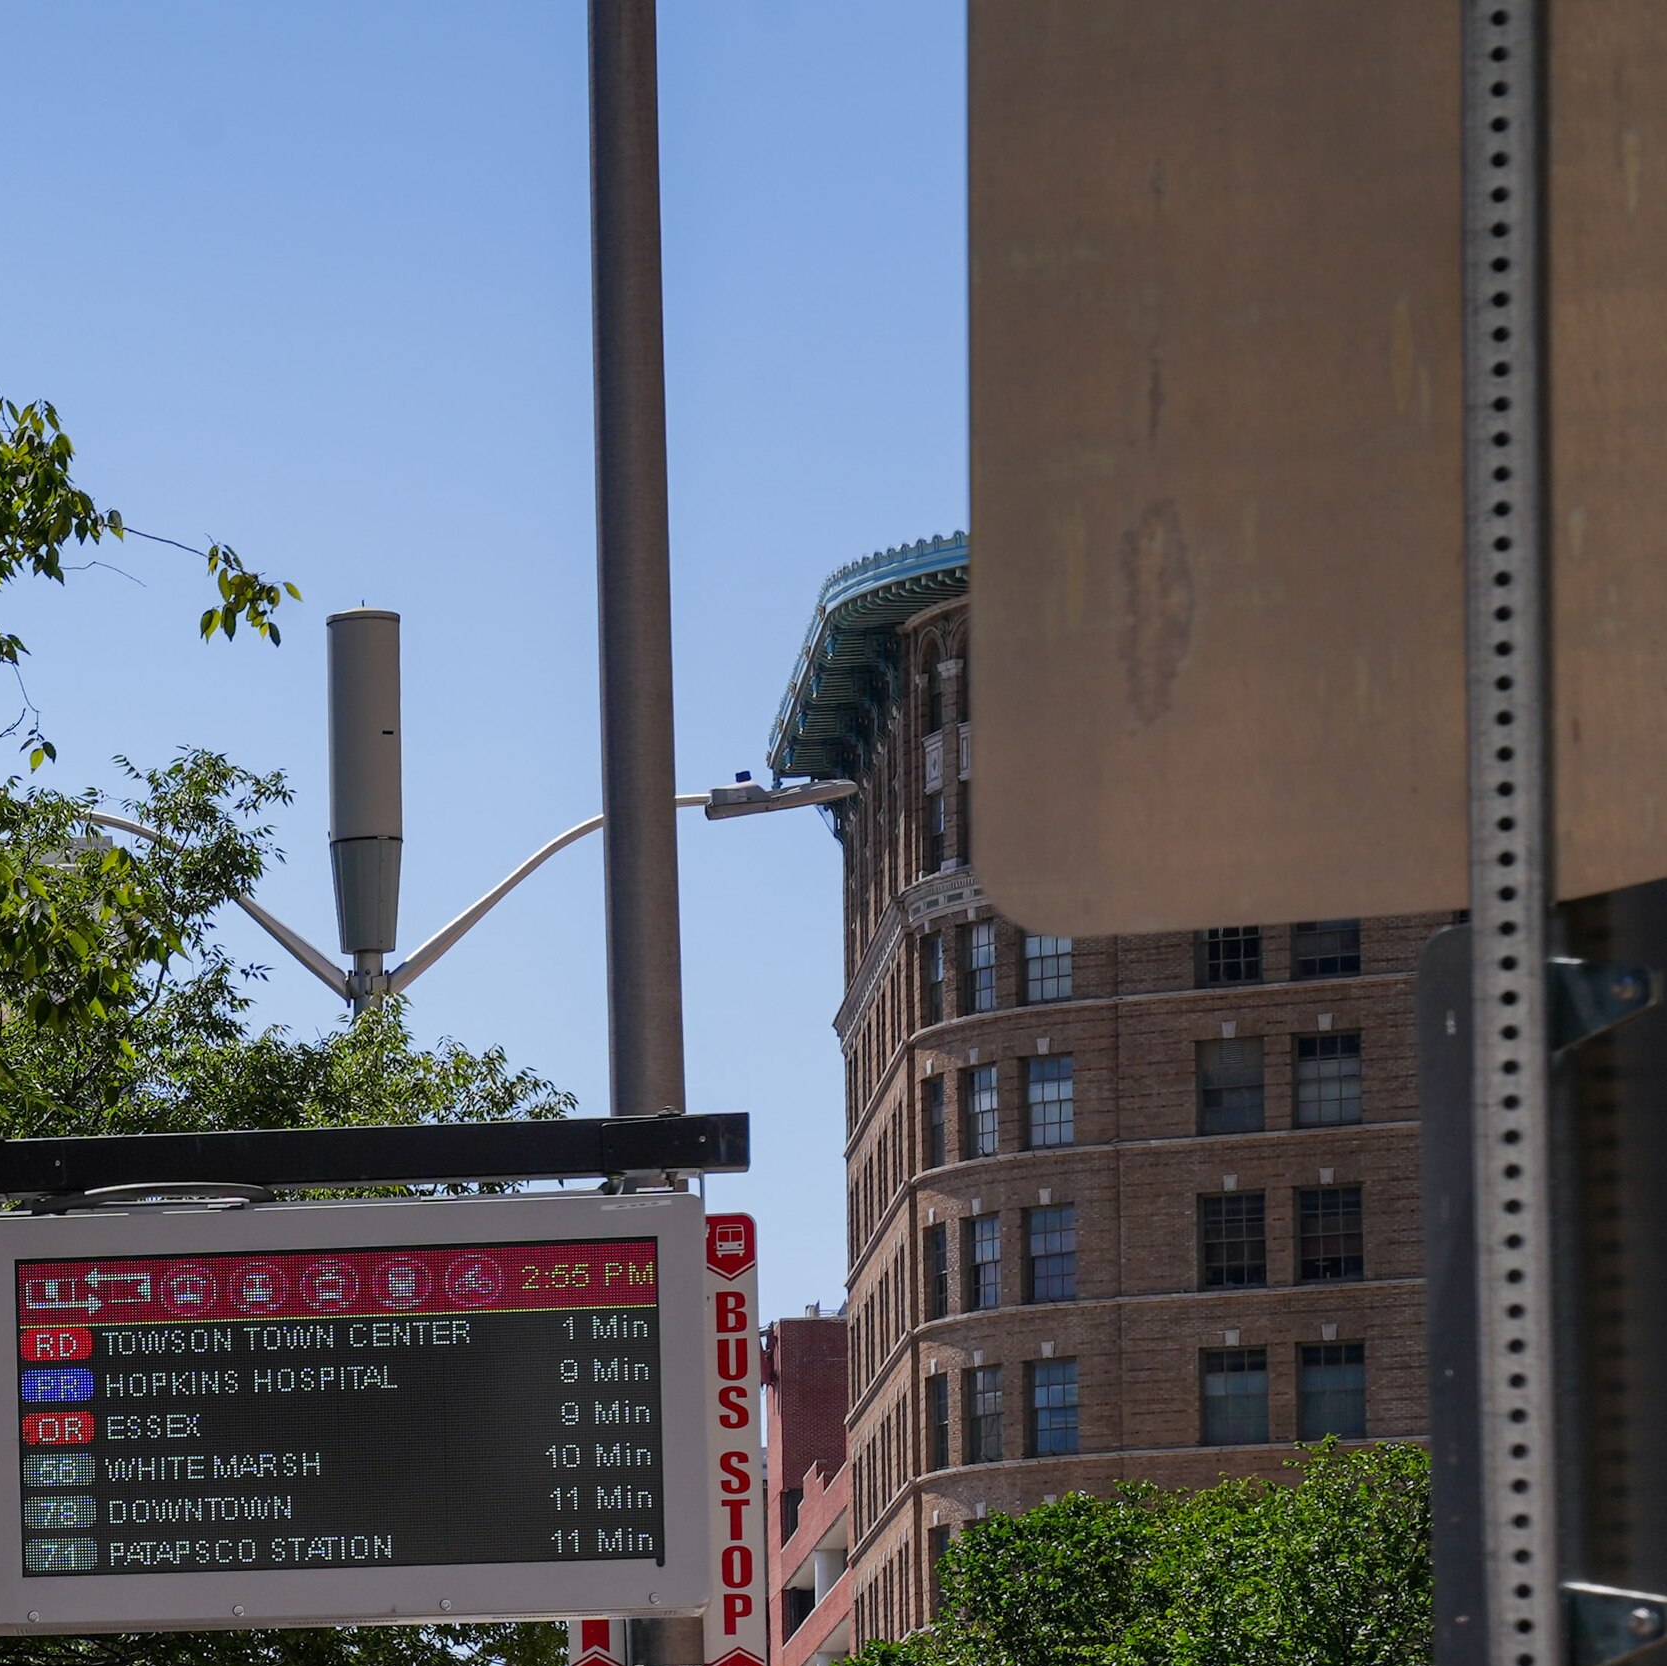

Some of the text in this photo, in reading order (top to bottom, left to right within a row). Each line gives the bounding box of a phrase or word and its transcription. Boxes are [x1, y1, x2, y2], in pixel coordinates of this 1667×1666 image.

[521, 1261, 655, 1289] 2:55 PM
[36, 1314, 649, 1358] RD TOWSON TOWN CENTER 1 Min
[36, 1357, 651, 1401] PR HOPKINS HOSPITAL 9 Min
[38, 1399, 651, 1442] OR ESSEX 9 Min
[104, 1455, 205, 1482] WHITE
[213, 1451, 321, 1480] MARSH
[544, 1444, 581, 1469] 10
[595, 1442, 652, 1468] Min
[715, 1291, 754, 1636] BUS STOP
[109, 1495, 293, 1525] DOWNTOWN
[549, 1486, 579, 1511] 11
[596, 1485, 653, 1510] Min
[109, 1538, 257, 1567] PATAPSCO
[271, 1534, 393, 1563] STATION
[550, 1528, 580, 1554] 11
[597, 1527, 654, 1553] Min
